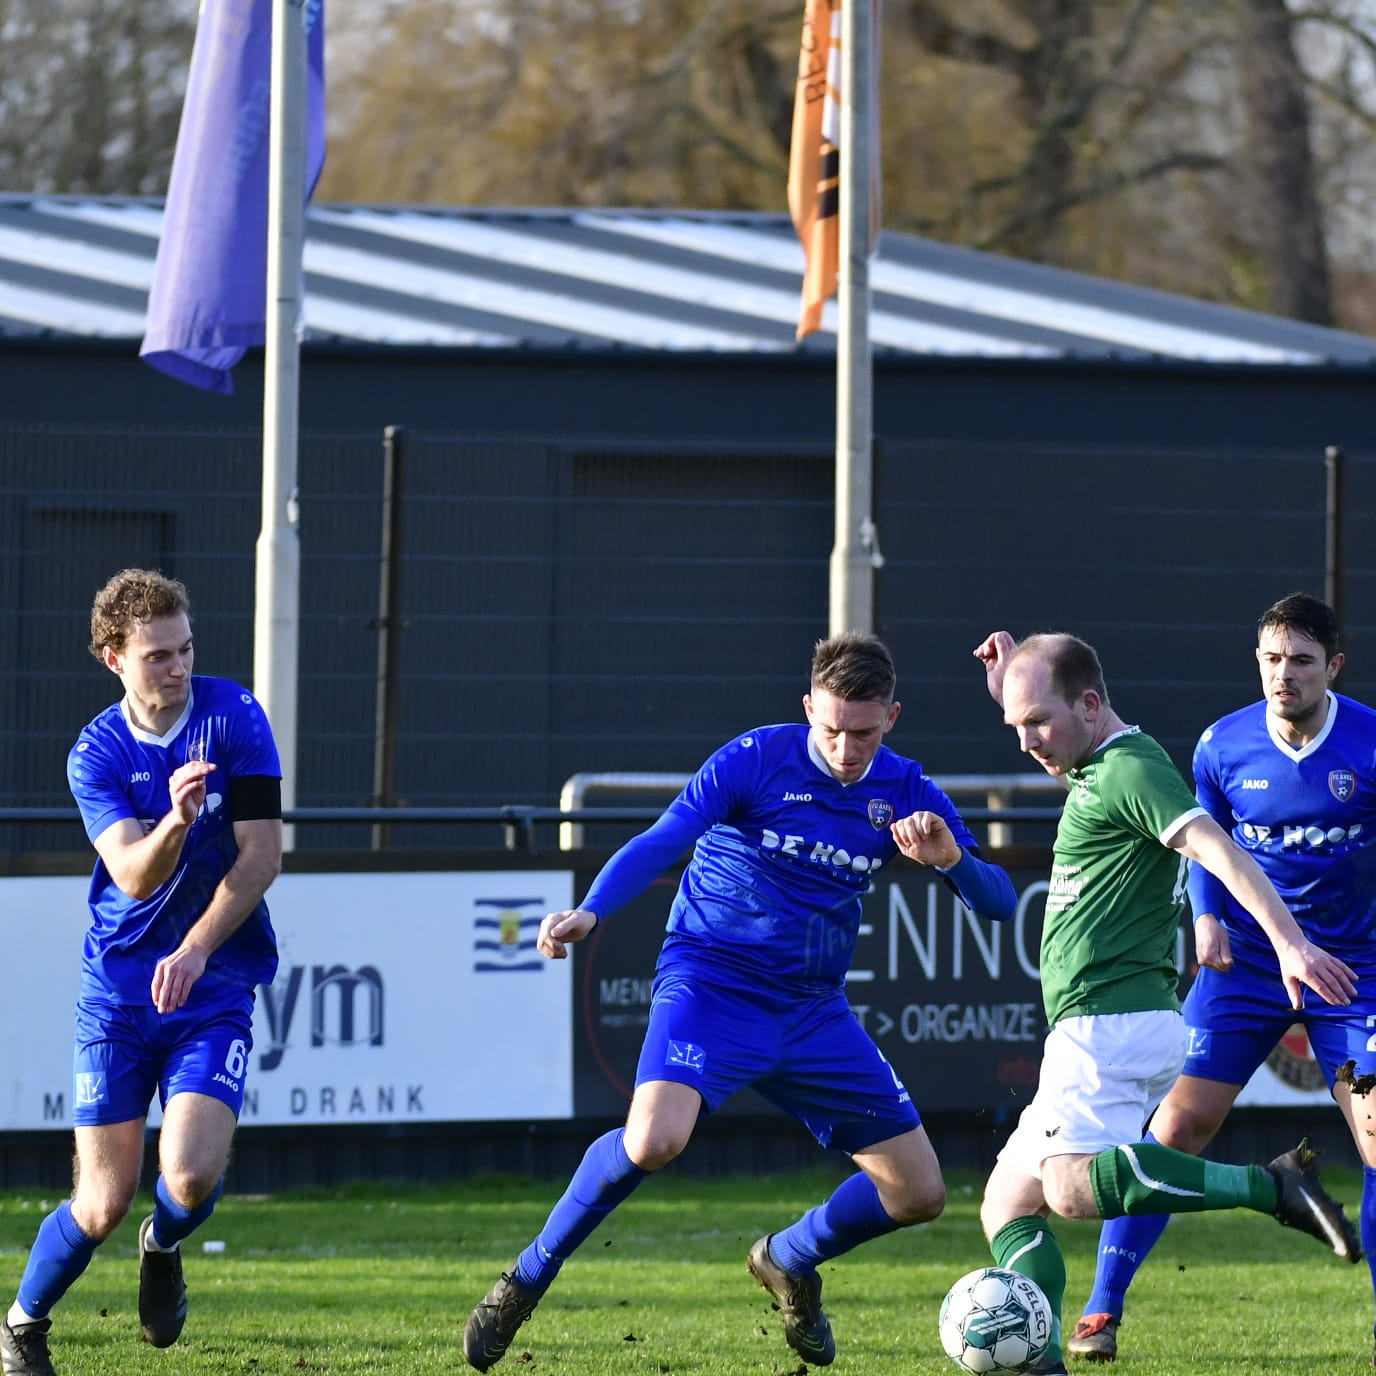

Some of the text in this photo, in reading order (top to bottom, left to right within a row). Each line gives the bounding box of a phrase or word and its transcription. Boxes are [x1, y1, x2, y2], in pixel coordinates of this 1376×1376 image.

[782, 791, 813, 802] JAKO
[1241, 779, 1270, 790] JAKO
[761, 828, 805, 859] DE
[901, 1003, 1037, 1043] ORGANIZE
[225, 1039, 247, 1078] 6
[211, 1072, 239, 1093] JAKO
[291, 1085, 425, 1116] DRANK
[1102, 1244, 1137, 1263] JAKO
[1017, 1282, 1047, 1340] SELECT
